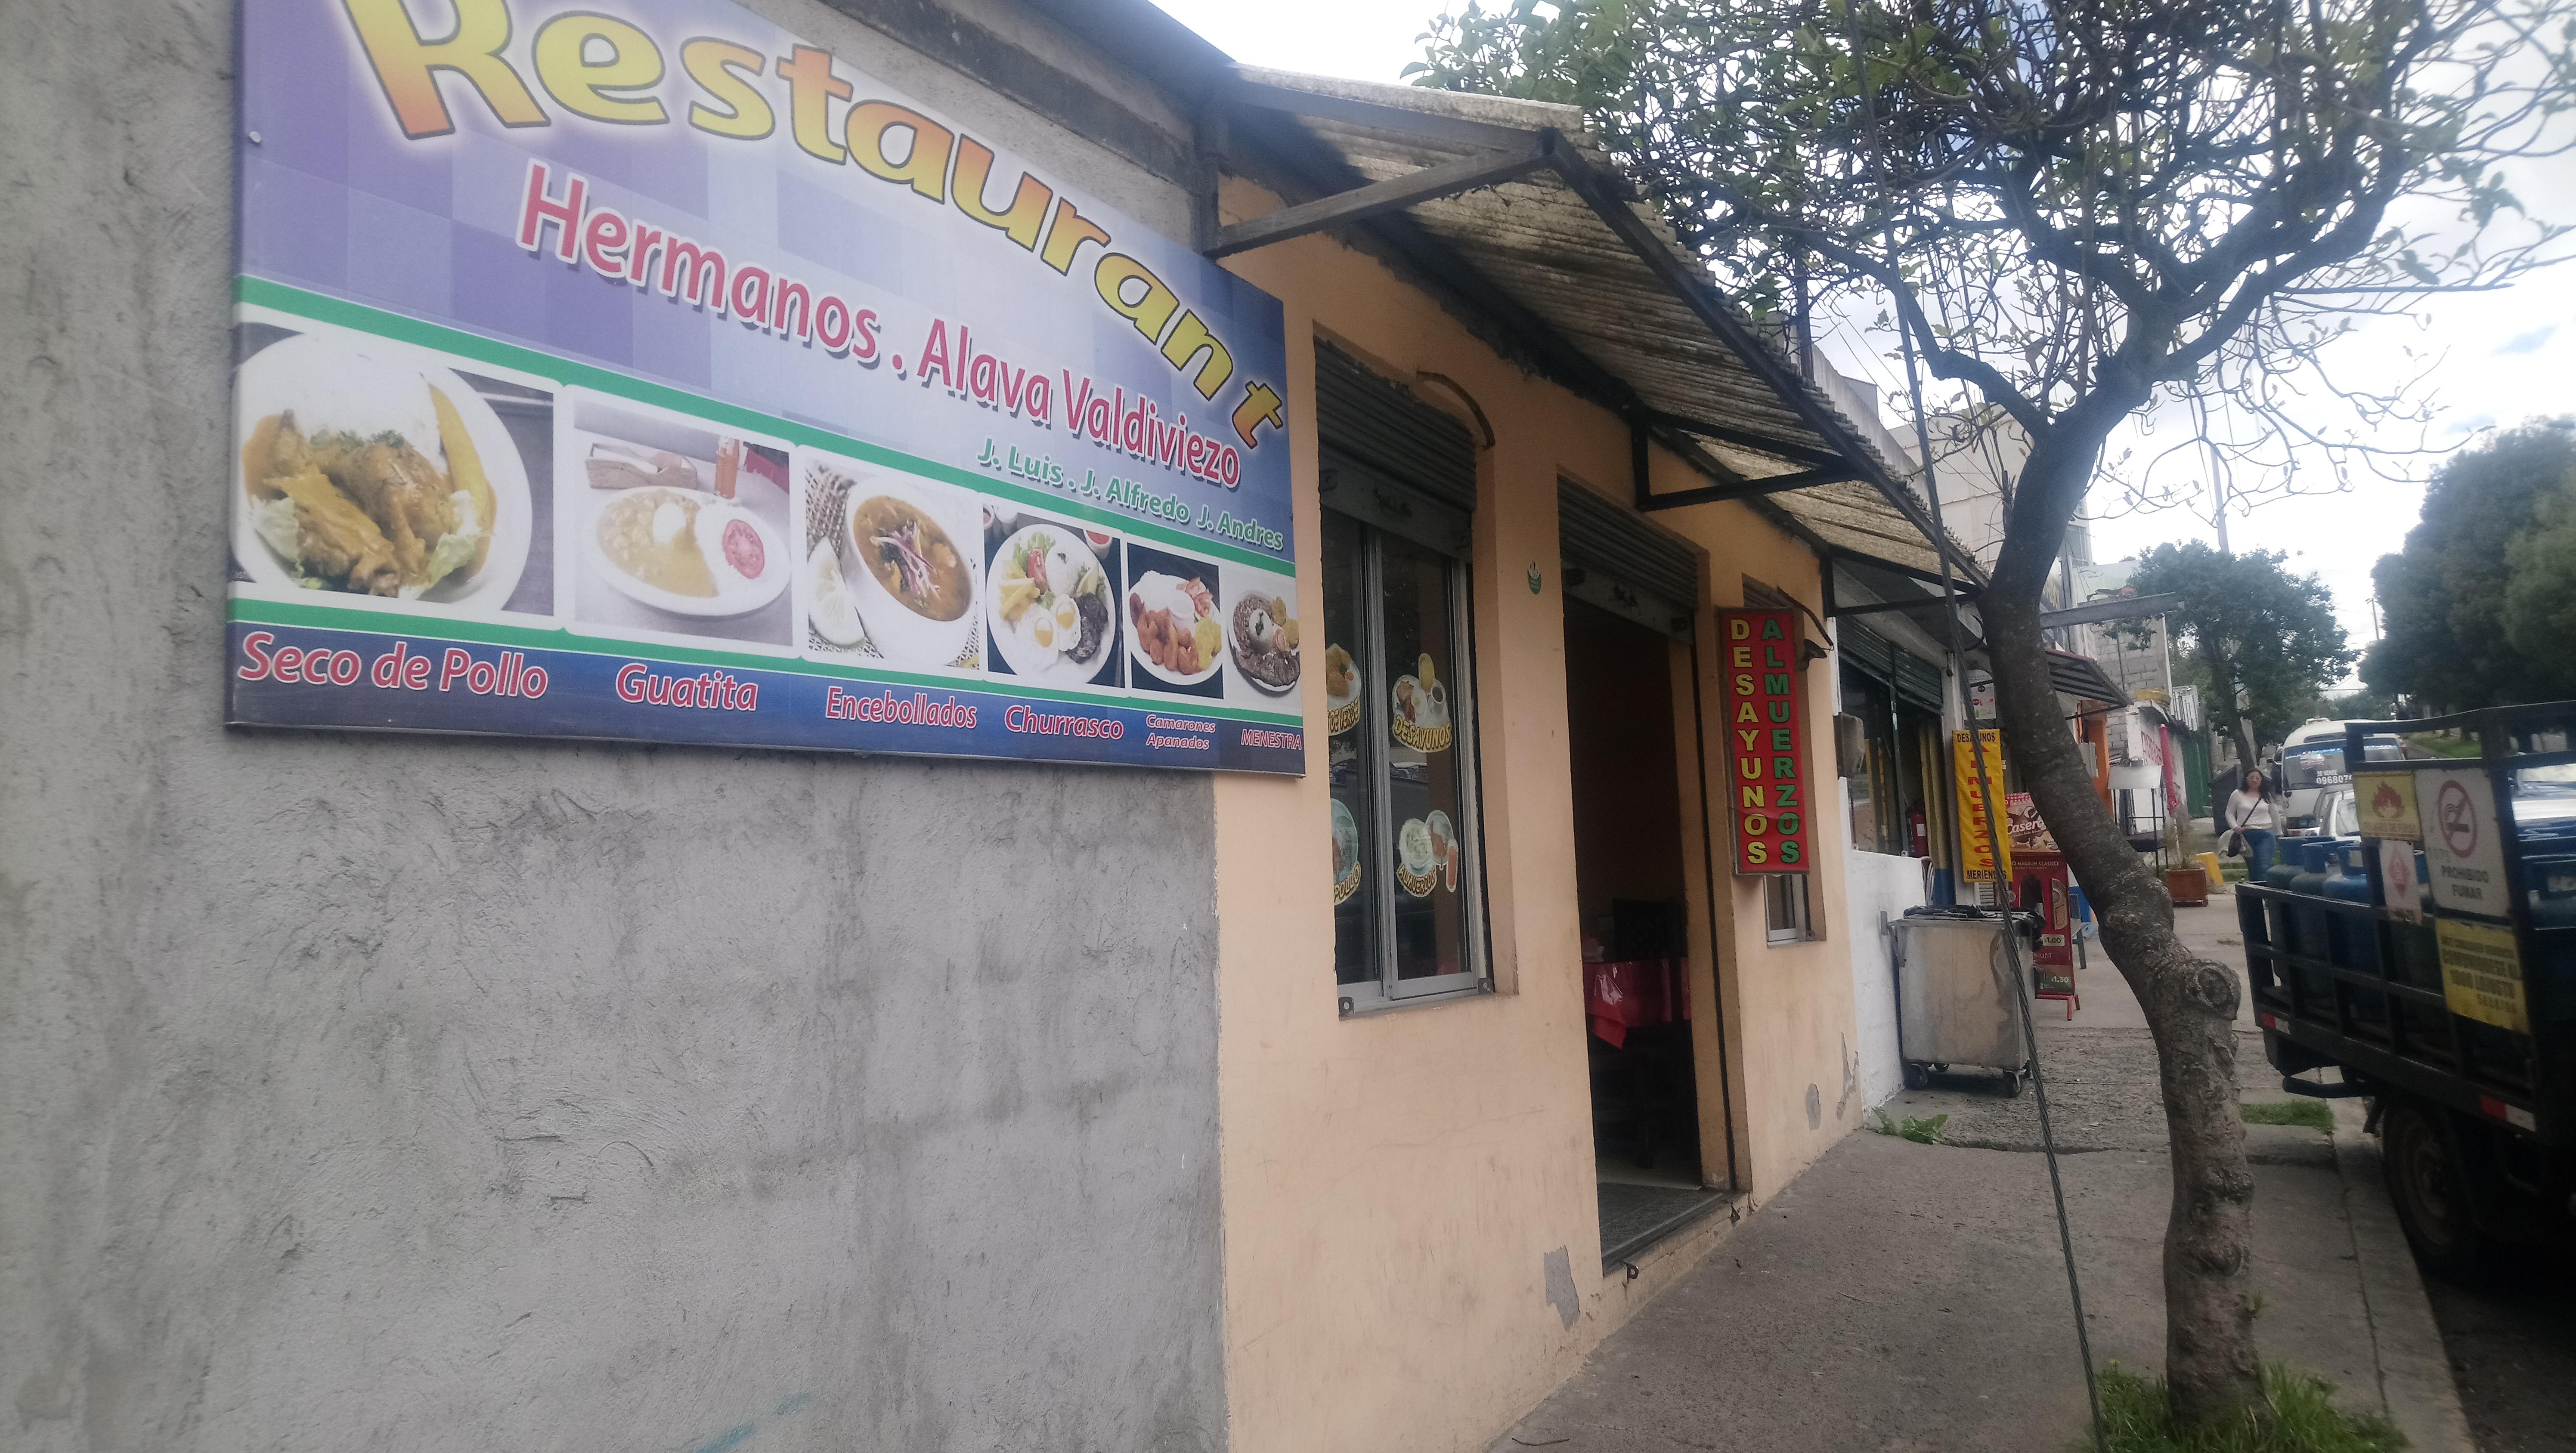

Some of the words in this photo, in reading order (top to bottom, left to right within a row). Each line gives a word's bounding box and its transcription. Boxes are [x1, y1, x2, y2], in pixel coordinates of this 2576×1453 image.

[345, 0, 1284, 449] Restaurant
[518, 160, 876, 363] Hermanos
[916, 318, 1052, 422] Alava
[1062, 369, 1240, 486] Valdiviezo
[978, 438, 1000, 465] J.
[1008, 446, 1063, 485] Luis
[1081, 470, 1099, 497] J.
[1105, 477, 1189, 522] Alfredo
[1198, 506, 1213, 530] J.
[1217, 512, 1283, 549] Andres
[237, 631, 360, 686] Seco
[372, 641, 428, 690] de
[440, 648, 548, 699] Pollo
[616, 663, 758, 712] Guatita
[825, 686, 977, 730] Encebollados
[1004, 705, 1124, 740] Churrasco
[1146, 714, 1216, 734] Camarones
[1339, 697, 1358, 730] VERDE
[1146, 732, 1210, 750] Apanados
[1241, 728, 1302, 750] MENESTRA
[1394, 715, 1451, 750] DESAYUNOS
[1730, 618, 1768, 864] DESAYUNOS
[1761, 618, 1800, 864] ALMUERZOS
[1957, 733, 1995, 742] DESNOS
[1334, 863, 1360, 903] POLLO
[1398, 864, 1436, 895] ALMUERZOS
[1967, 870, 2007, 880] MERIENS
